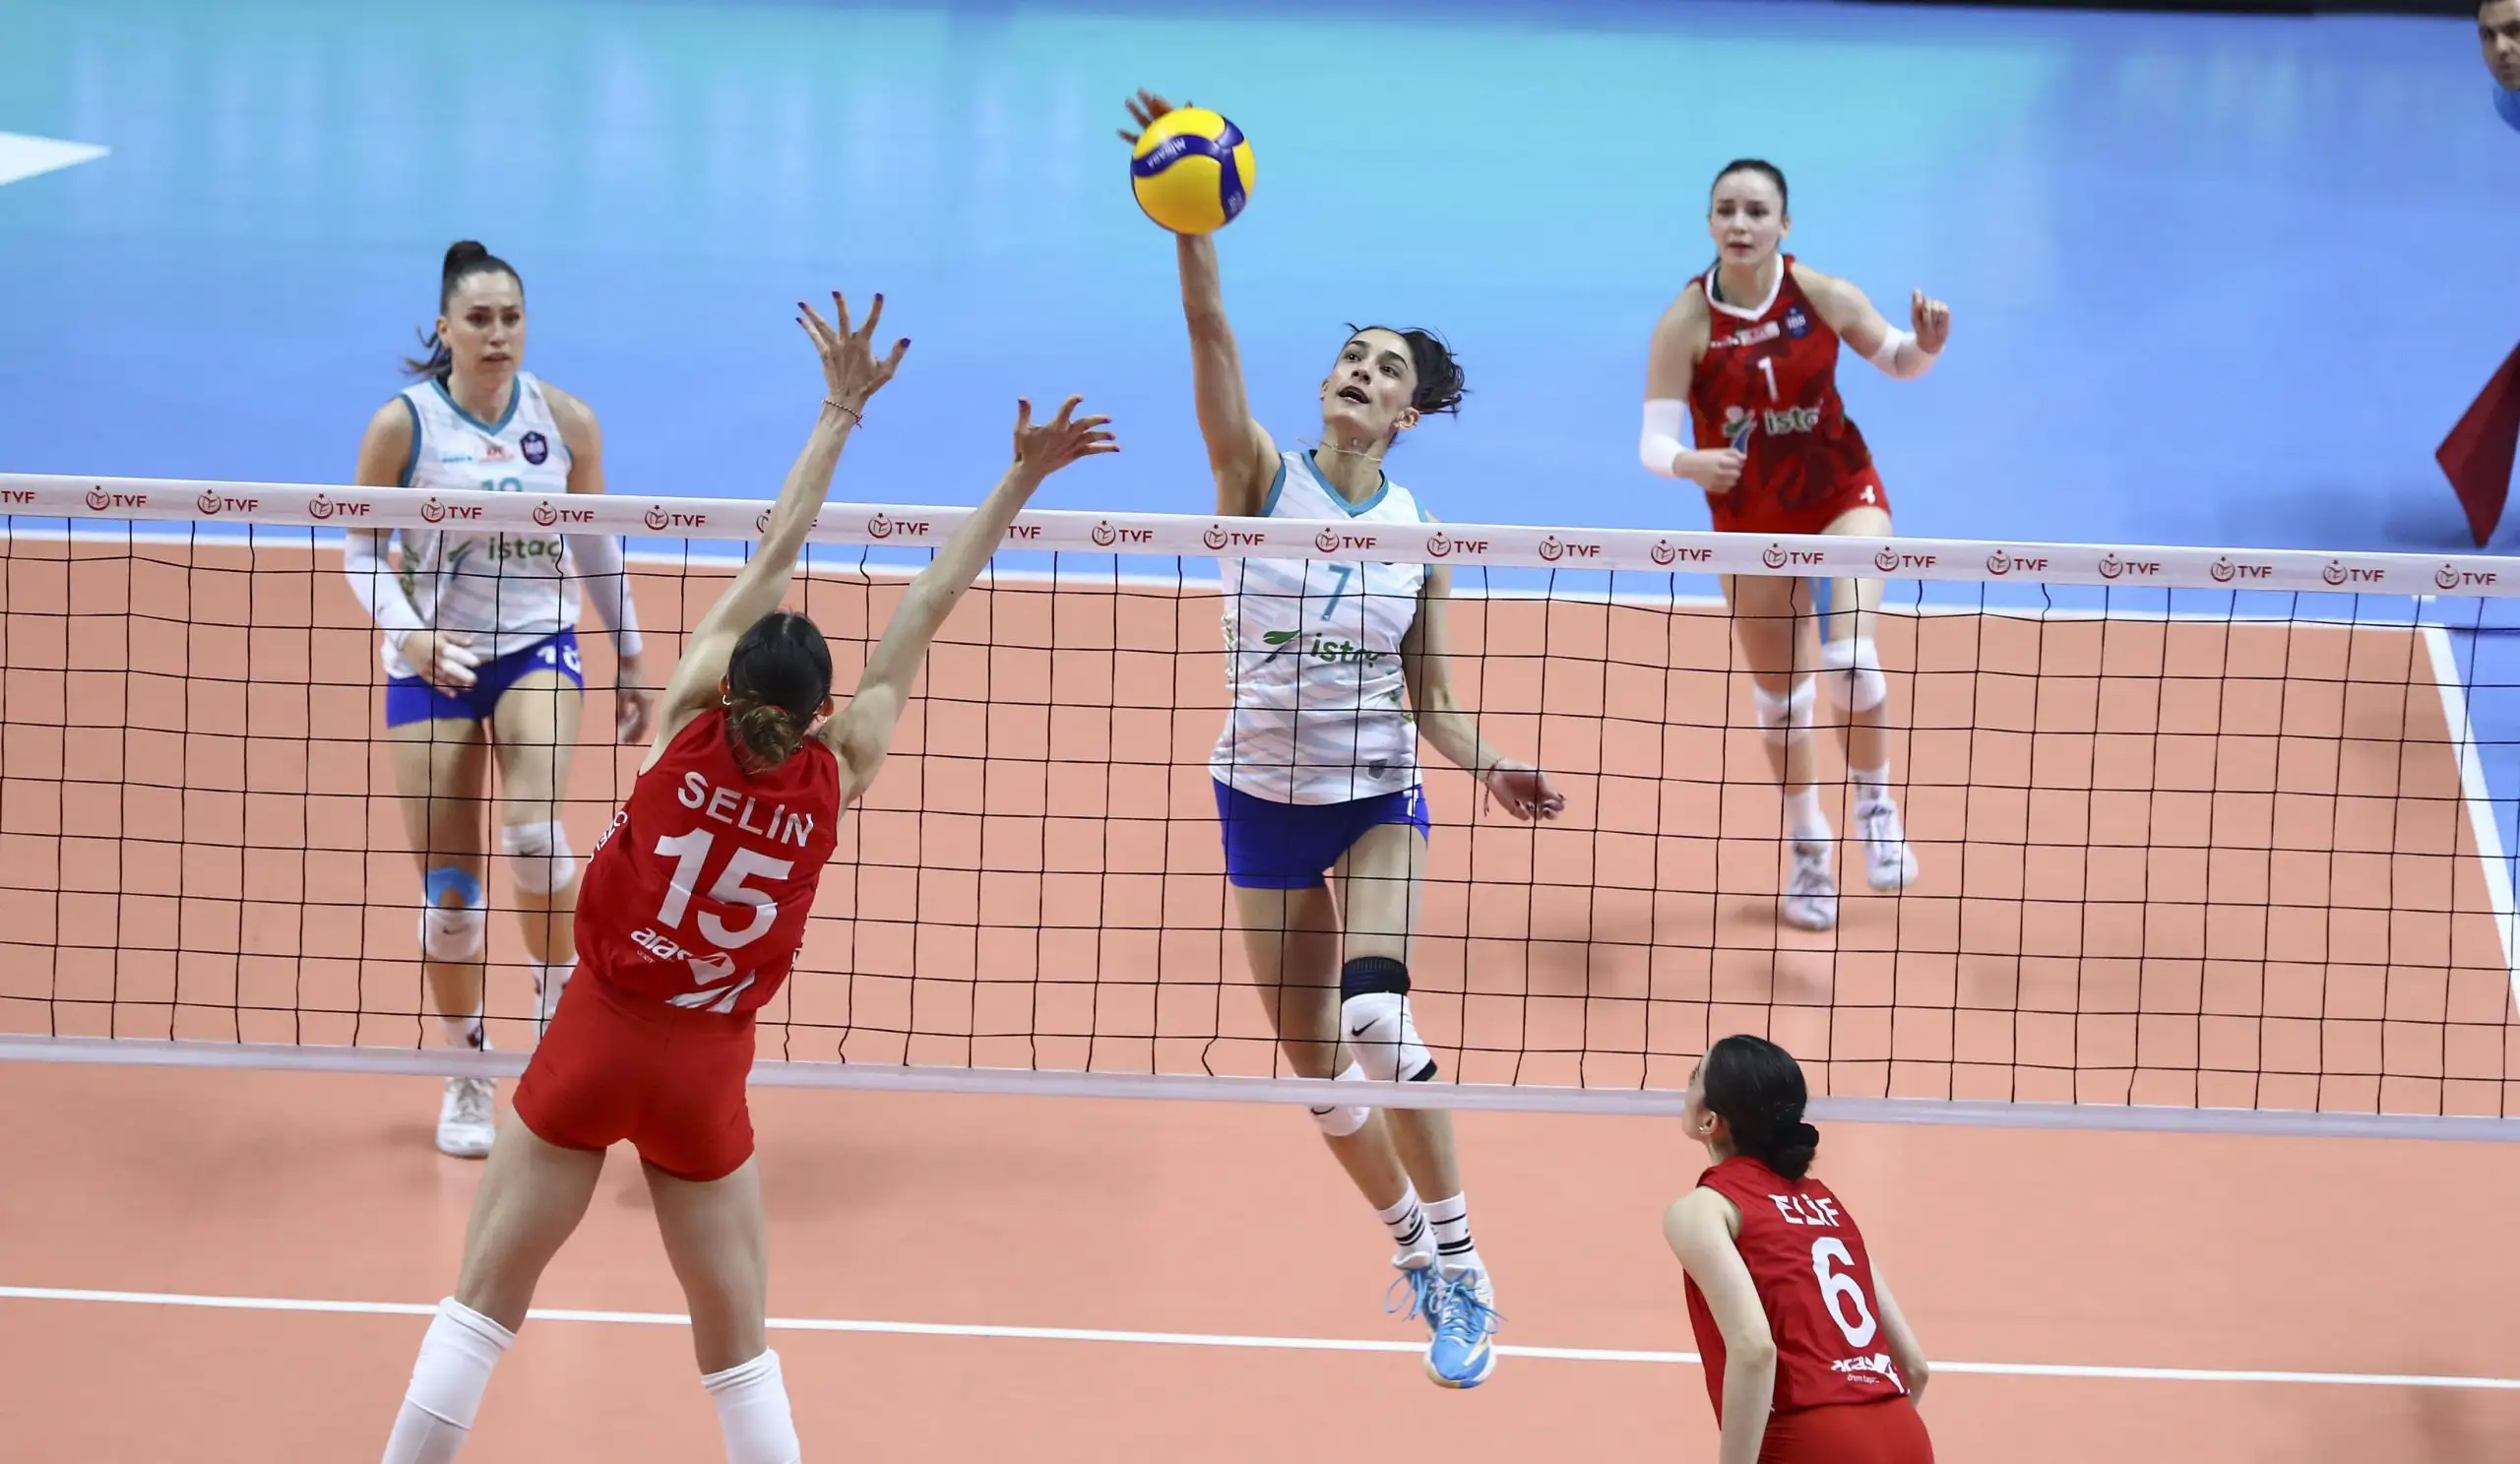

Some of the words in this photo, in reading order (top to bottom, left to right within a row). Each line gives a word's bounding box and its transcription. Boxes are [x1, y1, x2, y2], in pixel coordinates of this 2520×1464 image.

[1756, 355, 1780, 403] 1
[1, 490, 36, 504] TVF
[112, 494, 148, 508] TVF
[223, 498, 259, 512] TVF
[336, 502, 371, 515] TVF
[448, 506, 483, 519] TVF
[559, 509, 595, 523] TVF
[670, 513, 706, 527] TVF
[895, 521, 930, 534] TVF
[1007, 524, 1042, 538] TVF
[1118, 528, 1154, 541] TVF
[1229, 532, 1265, 545] TVF
[1342, 536, 1377, 548] TVF
[1454, 540, 1489, 552] TVF
[1565, 542, 1601, 556] TVF
[1676, 546, 1712, 560] TVF
[1789, 550, 1824, 564] TVF
[1901, 554, 1936, 567] TVF
[2013, 557, 2048, 571] TVF
[2125, 561, 2161, 575] TVF
[2237, 565, 2273, 579] TVF
[2349, 569, 2384, 582] TVF
[2461, 573, 2496, 586] TVF
[1320, 563, 1354, 621] 7
[654, 826, 795, 950] 15
[1810, 1237, 1878, 1349] 6
